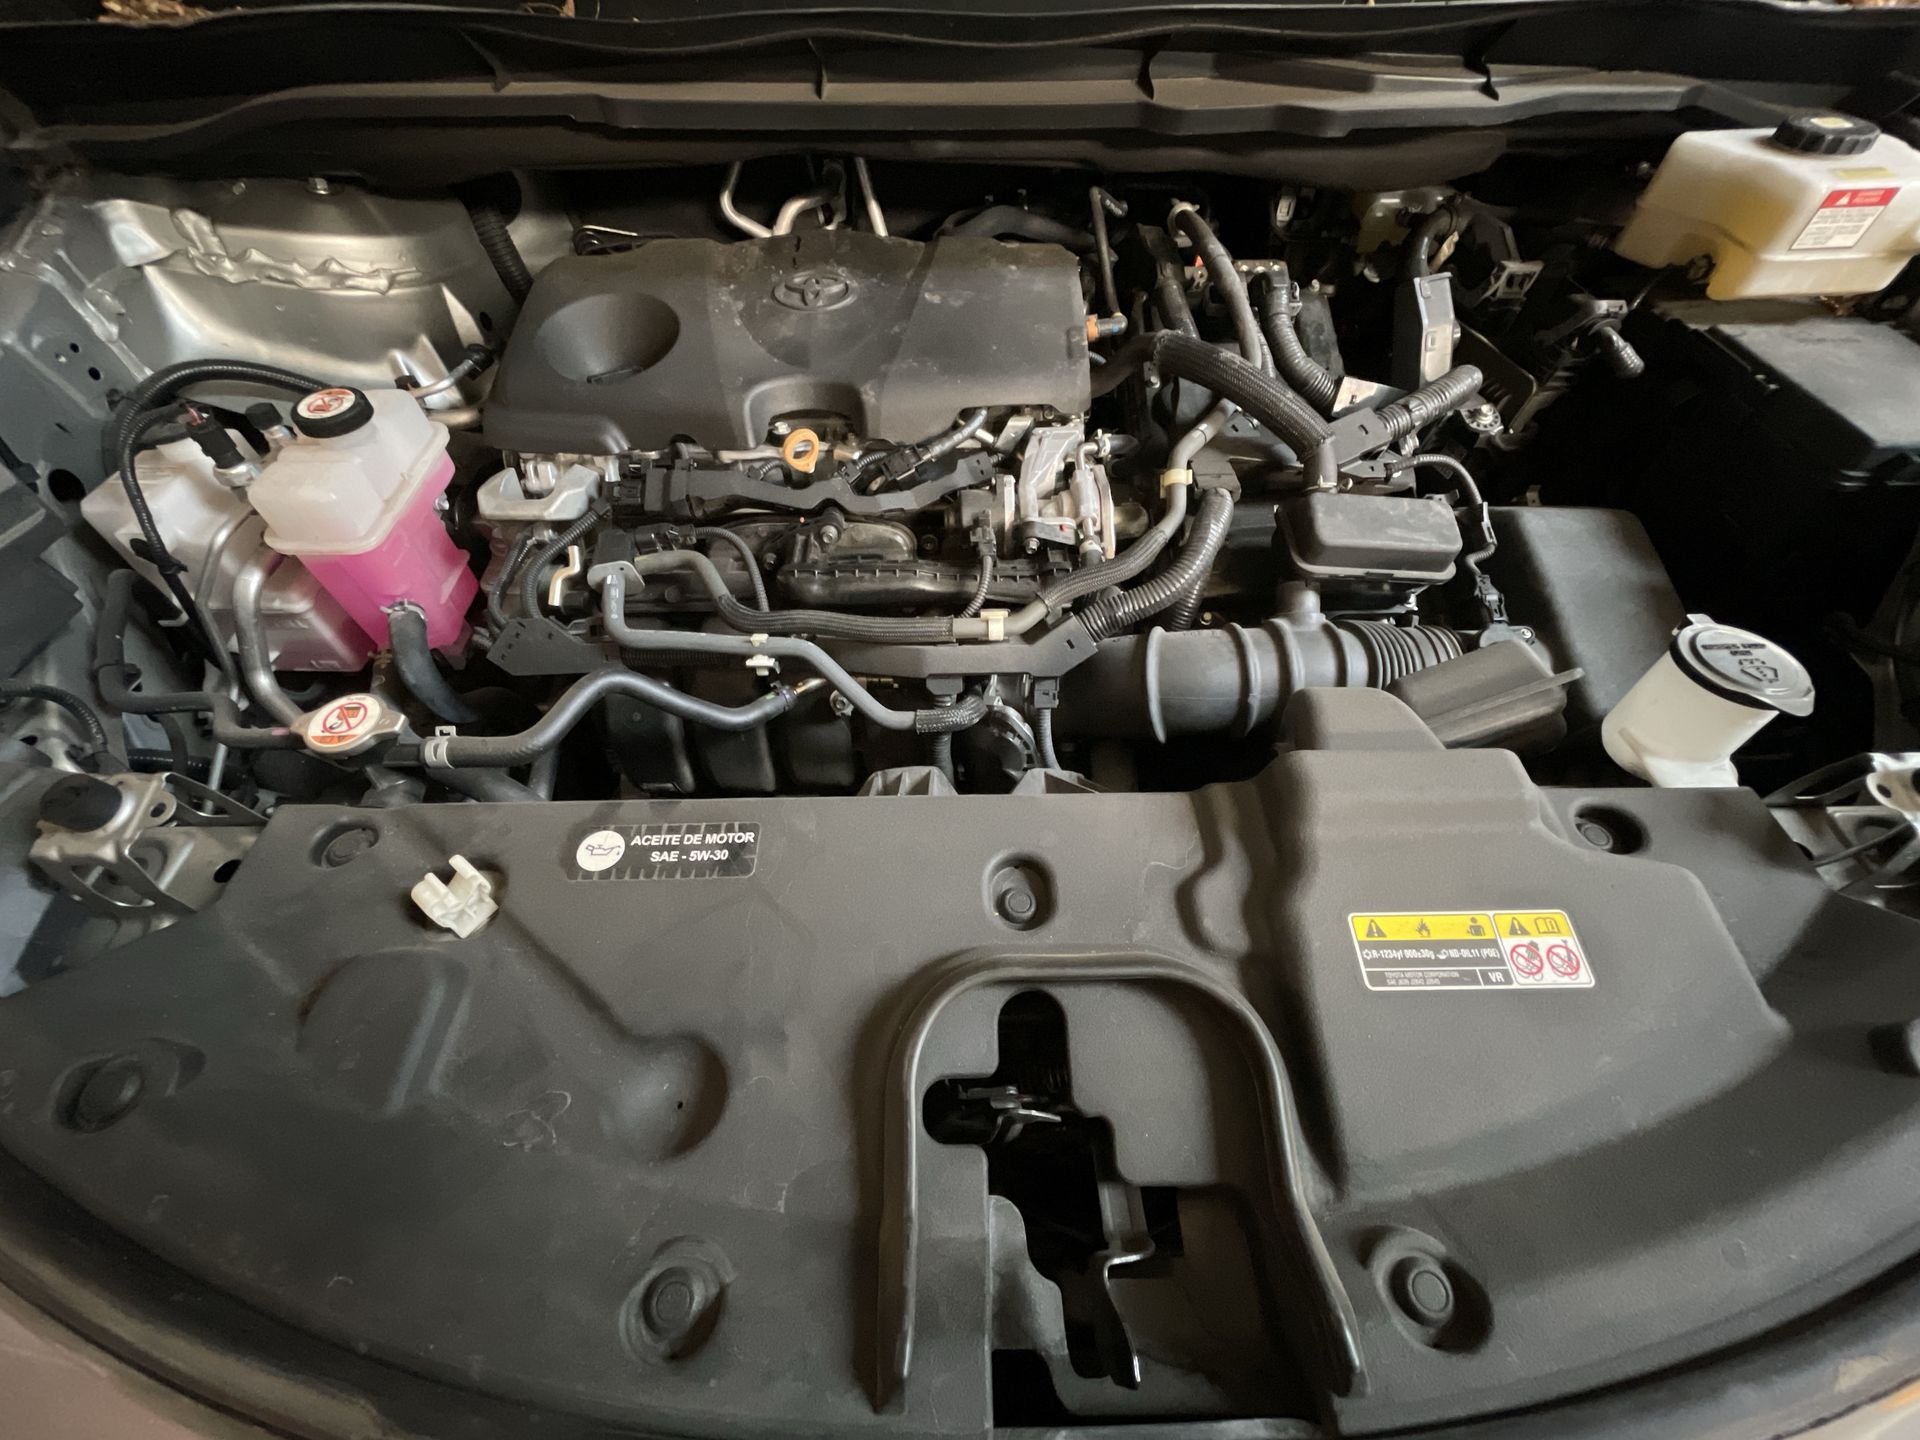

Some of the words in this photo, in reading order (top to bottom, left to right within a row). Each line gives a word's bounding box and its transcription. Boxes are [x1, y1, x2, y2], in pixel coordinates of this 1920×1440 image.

[630, 834, 681, 846] ACEITE
[683, 833, 703, 845] DE
[705, 832, 755, 844] MOTOR
[650, 851, 679, 862] SAE
[689, 850, 729, 861] 5W-30
[1488, 971, 1505, 983] VR
